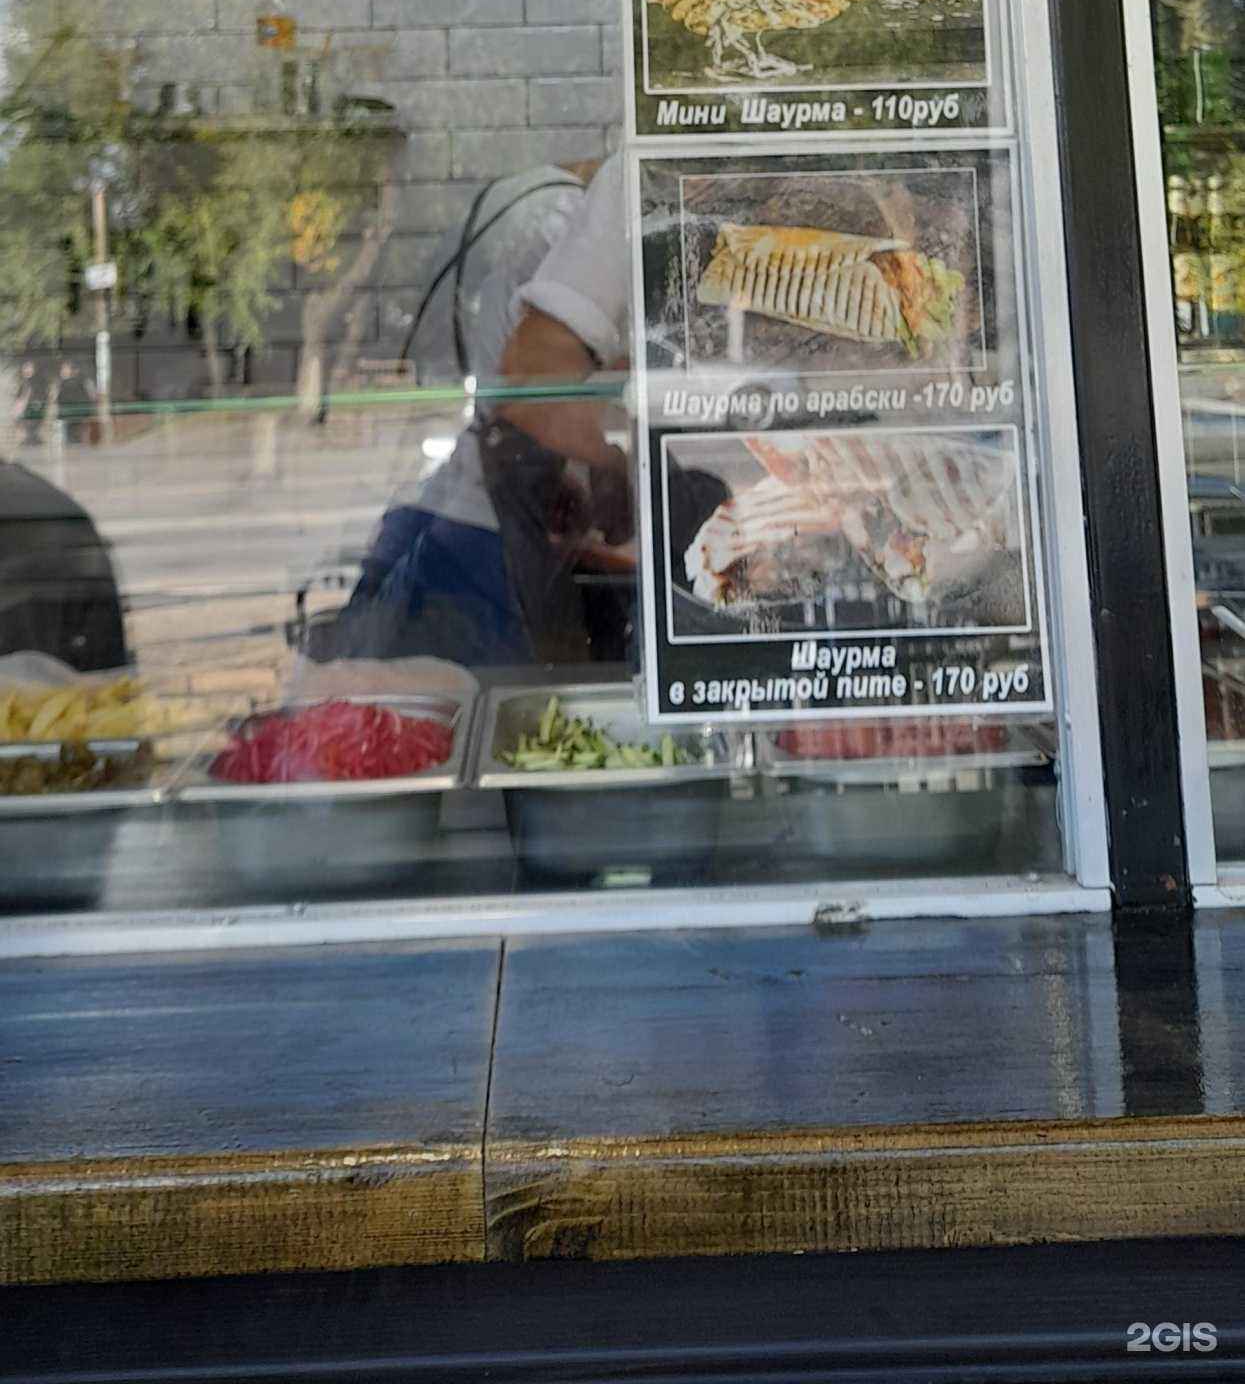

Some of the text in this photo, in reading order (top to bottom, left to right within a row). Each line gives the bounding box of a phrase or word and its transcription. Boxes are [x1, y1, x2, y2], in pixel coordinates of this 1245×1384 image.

[656, 100, 726, 126] Мини
[741, 98, 846, 128] Шаурма
[871, 93, 960, 124] 110руб
[663, 380, 1015, 419] Шаурма по арабски -170 руб
[791, 640, 896, 672] Шаурма
[669, 681, 685, 705] в
[692, 668, 830, 707] закрытой
[836, 674, 907, 698] пите
[932, 668, 975, 695] 170
[982, 664, 1029, 699] руб
